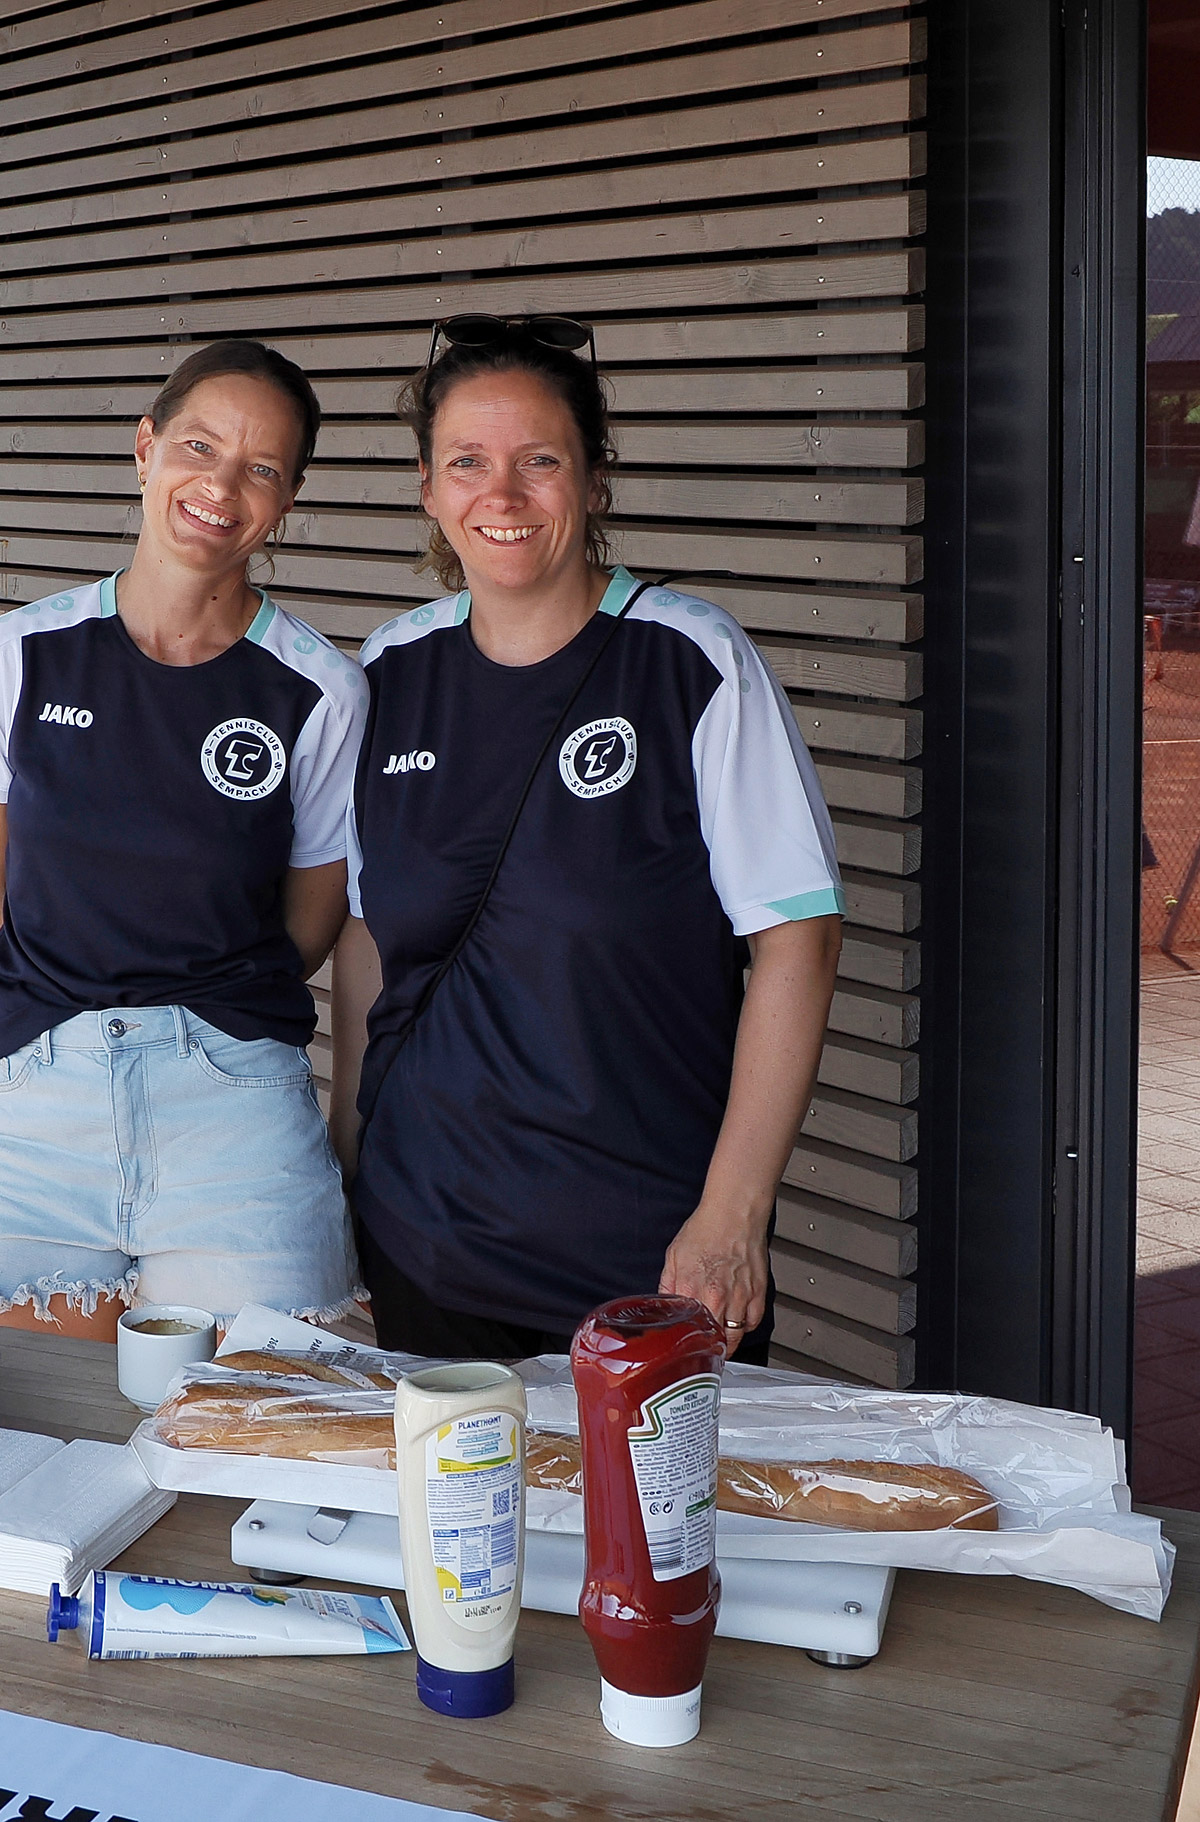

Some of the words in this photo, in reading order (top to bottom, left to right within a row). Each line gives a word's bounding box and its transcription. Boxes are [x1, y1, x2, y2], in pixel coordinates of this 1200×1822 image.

[38, 702, 93, 729] JAKO
[212, 721, 280, 751] TENNISCLUB
[383, 750, 436, 775] JAKO
[211, 774, 268, 798] SEMPACH
[570, 775, 623, 797] SEMPACH
